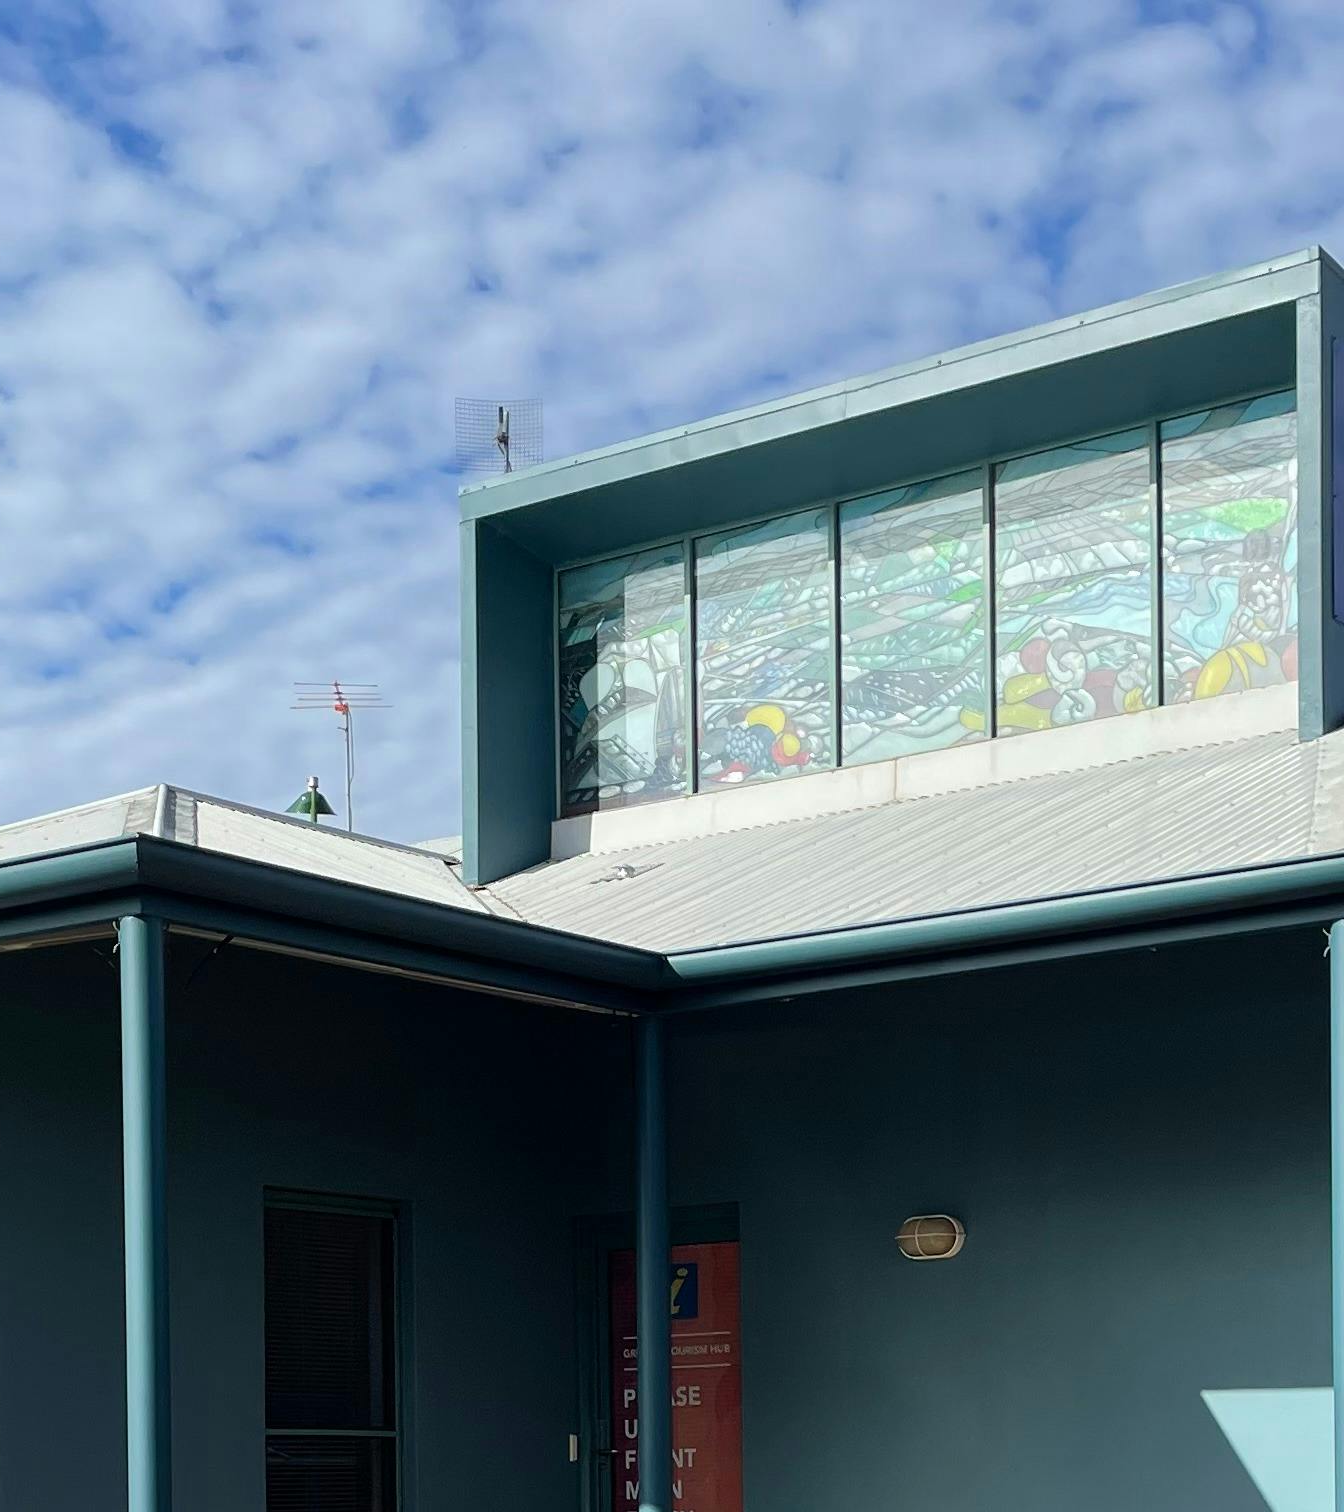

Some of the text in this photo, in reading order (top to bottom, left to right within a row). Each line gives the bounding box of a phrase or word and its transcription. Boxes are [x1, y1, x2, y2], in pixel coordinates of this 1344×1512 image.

[670, 1343, 731, 1355] OURISM HUB
[624, 1385, 702, 1409] PSE
[625, 1448, 697, 1470] FNT
[625, 1480, 683, 1501] MN
